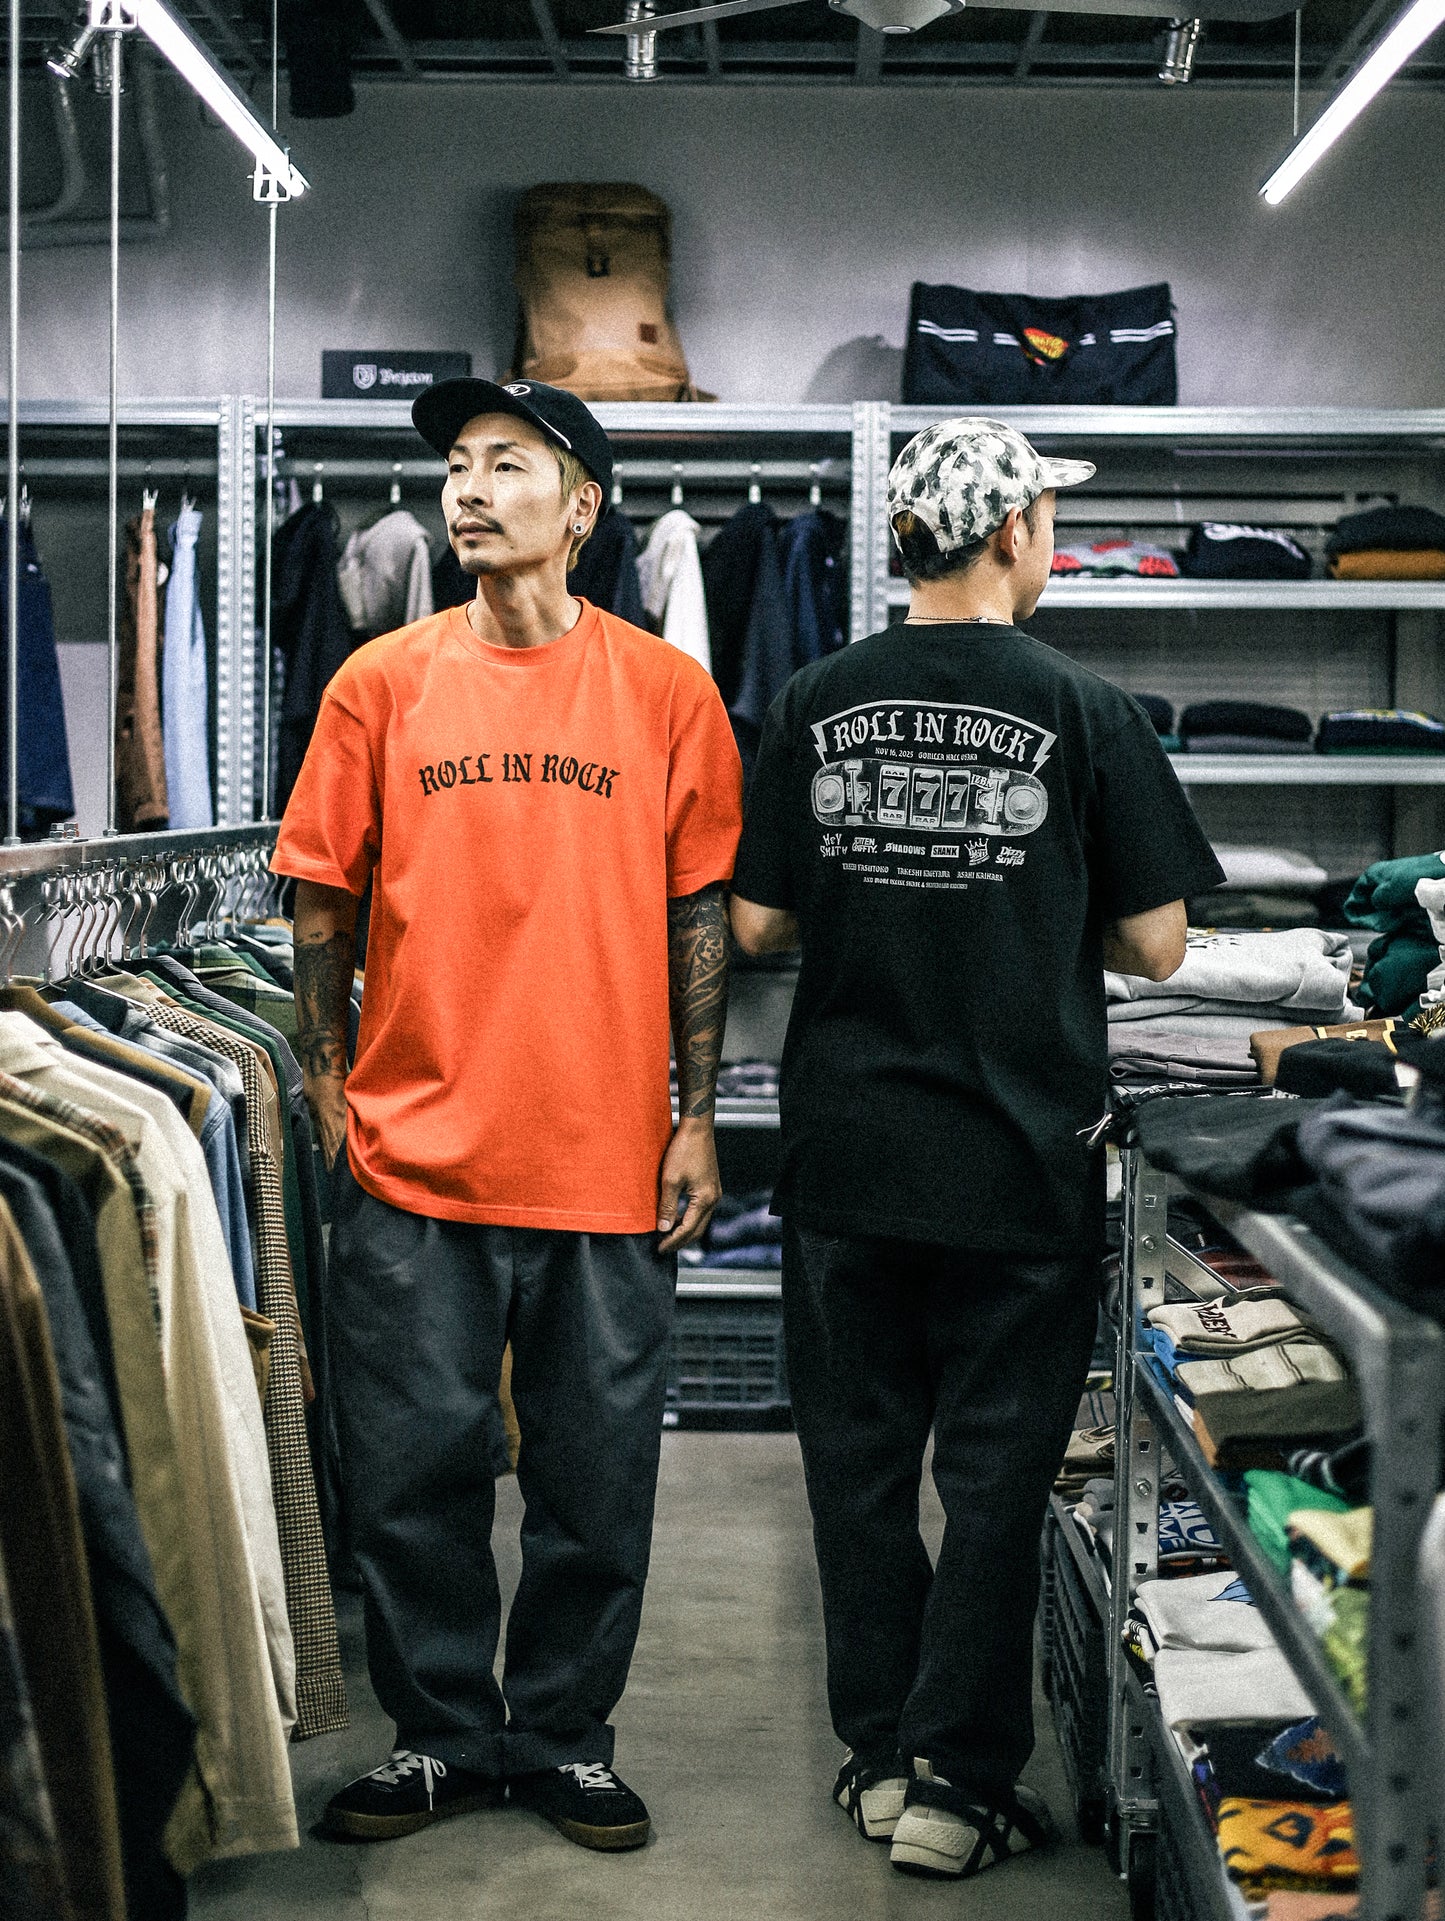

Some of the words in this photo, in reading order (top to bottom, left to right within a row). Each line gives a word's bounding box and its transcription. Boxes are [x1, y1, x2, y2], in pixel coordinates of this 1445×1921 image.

[833, 710, 905, 752] ROLL
[914, 711, 948, 743] IN
[953, 715, 1034, 762] ROCK
[875, 747, 888, 755] NOV
[889, 748, 898, 757] 16,
[898, 749, 914, 758] 2025
[418, 754, 493, 796] ROLL
[502, 753, 532, 783] IN
[541, 754, 621, 799] ROCK
[882, 779, 907, 807] 7
[915, 781, 940, 810] 7
[948, 783, 968, 810] 7
